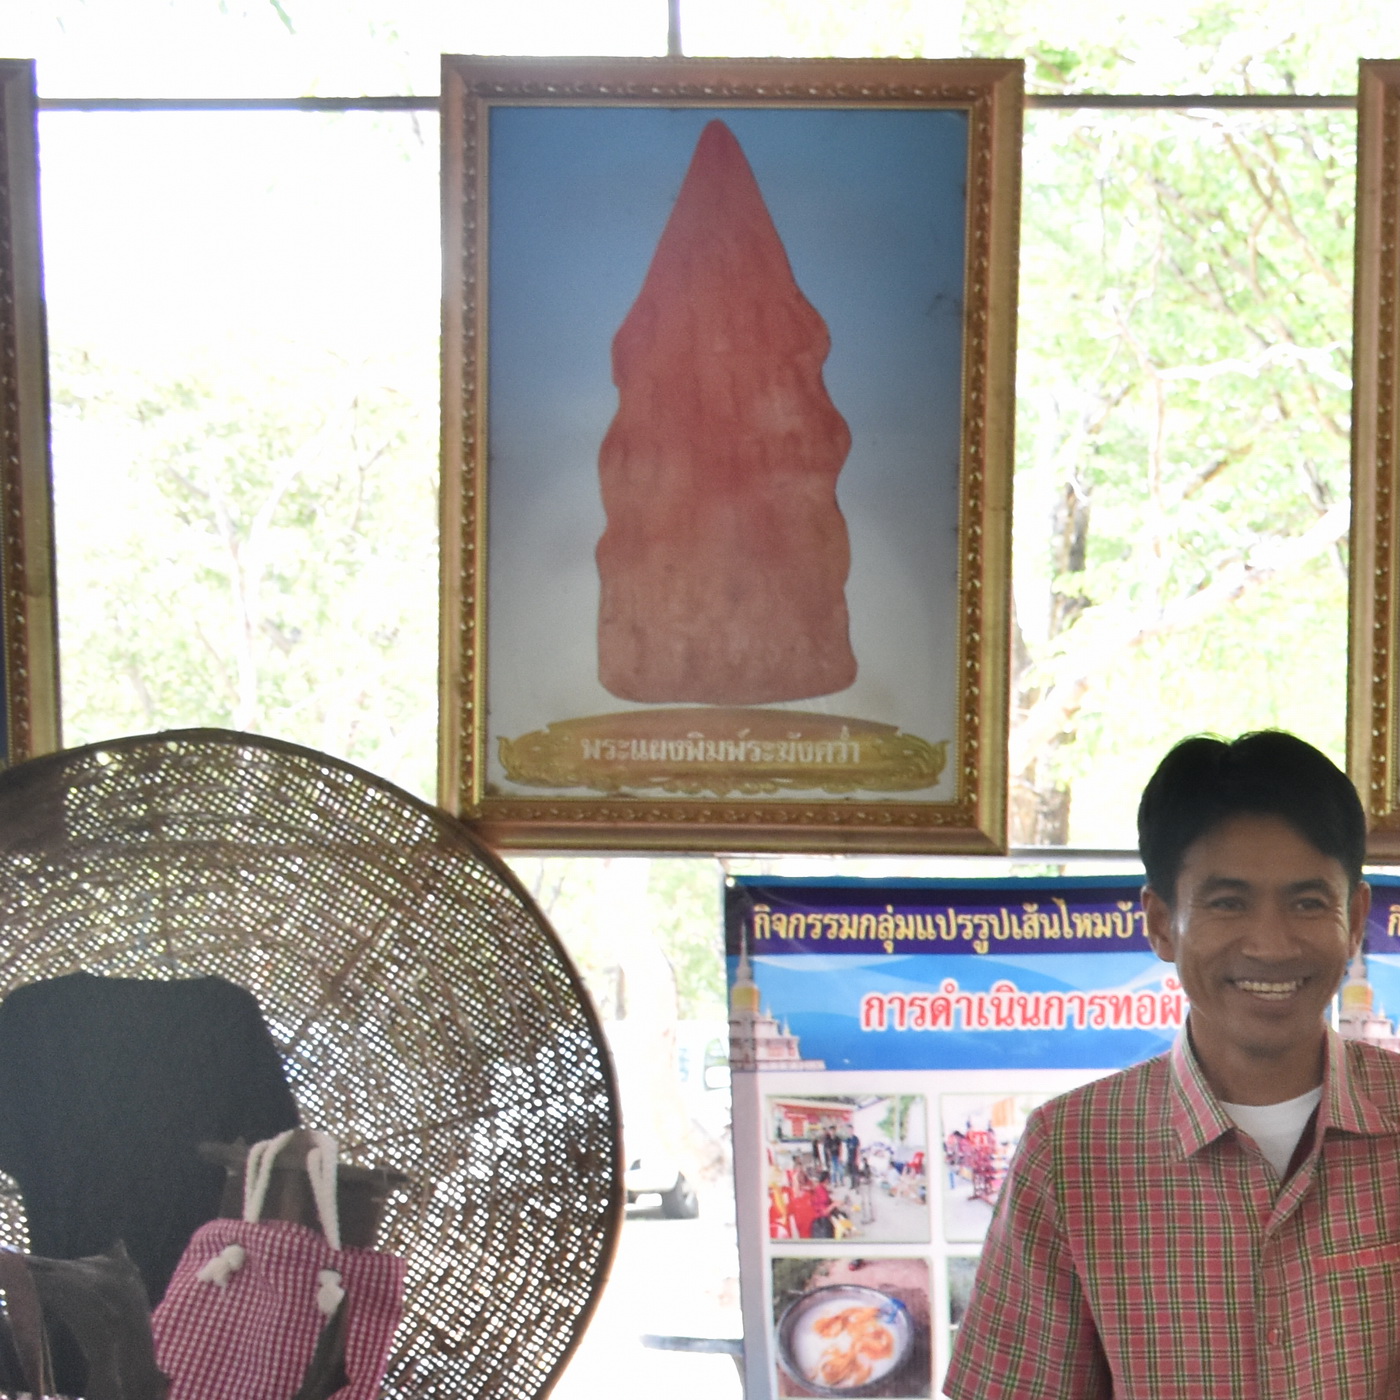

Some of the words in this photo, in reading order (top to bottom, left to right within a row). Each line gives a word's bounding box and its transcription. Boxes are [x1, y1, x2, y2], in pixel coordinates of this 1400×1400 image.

[753, 897, 1149, 956] กิจกรรมกลุ่มแปรรูปเส้นไหมบ้า
[863, 978, 1191, 1028] การดำเนินการทอผ้
